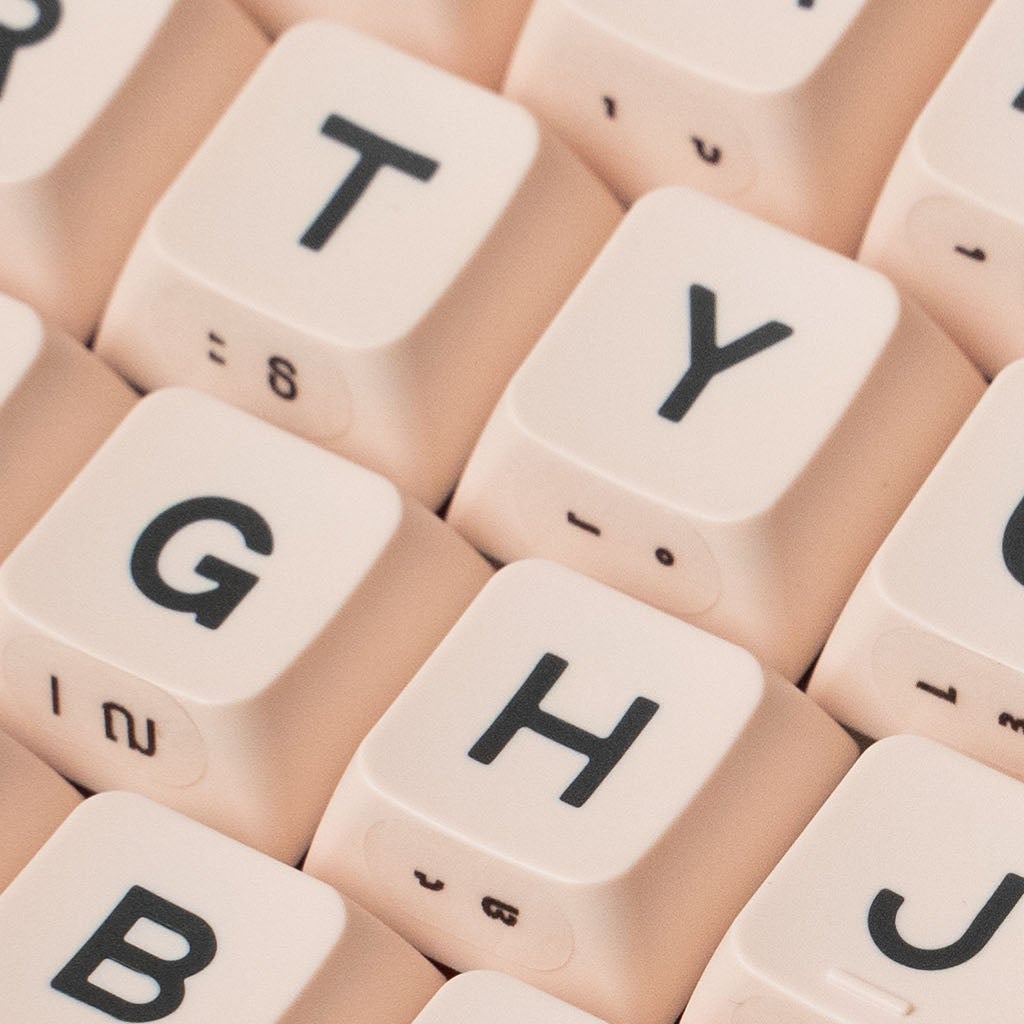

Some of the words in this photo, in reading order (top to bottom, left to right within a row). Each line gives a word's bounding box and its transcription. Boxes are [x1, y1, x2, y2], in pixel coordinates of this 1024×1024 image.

[298, 112, 442, 254] T
[656, 282, 796, 425] Y
[128, 494, 276, 632] G
[466, 651, 662, 810] H
[48, 883, 219, 1024] B
